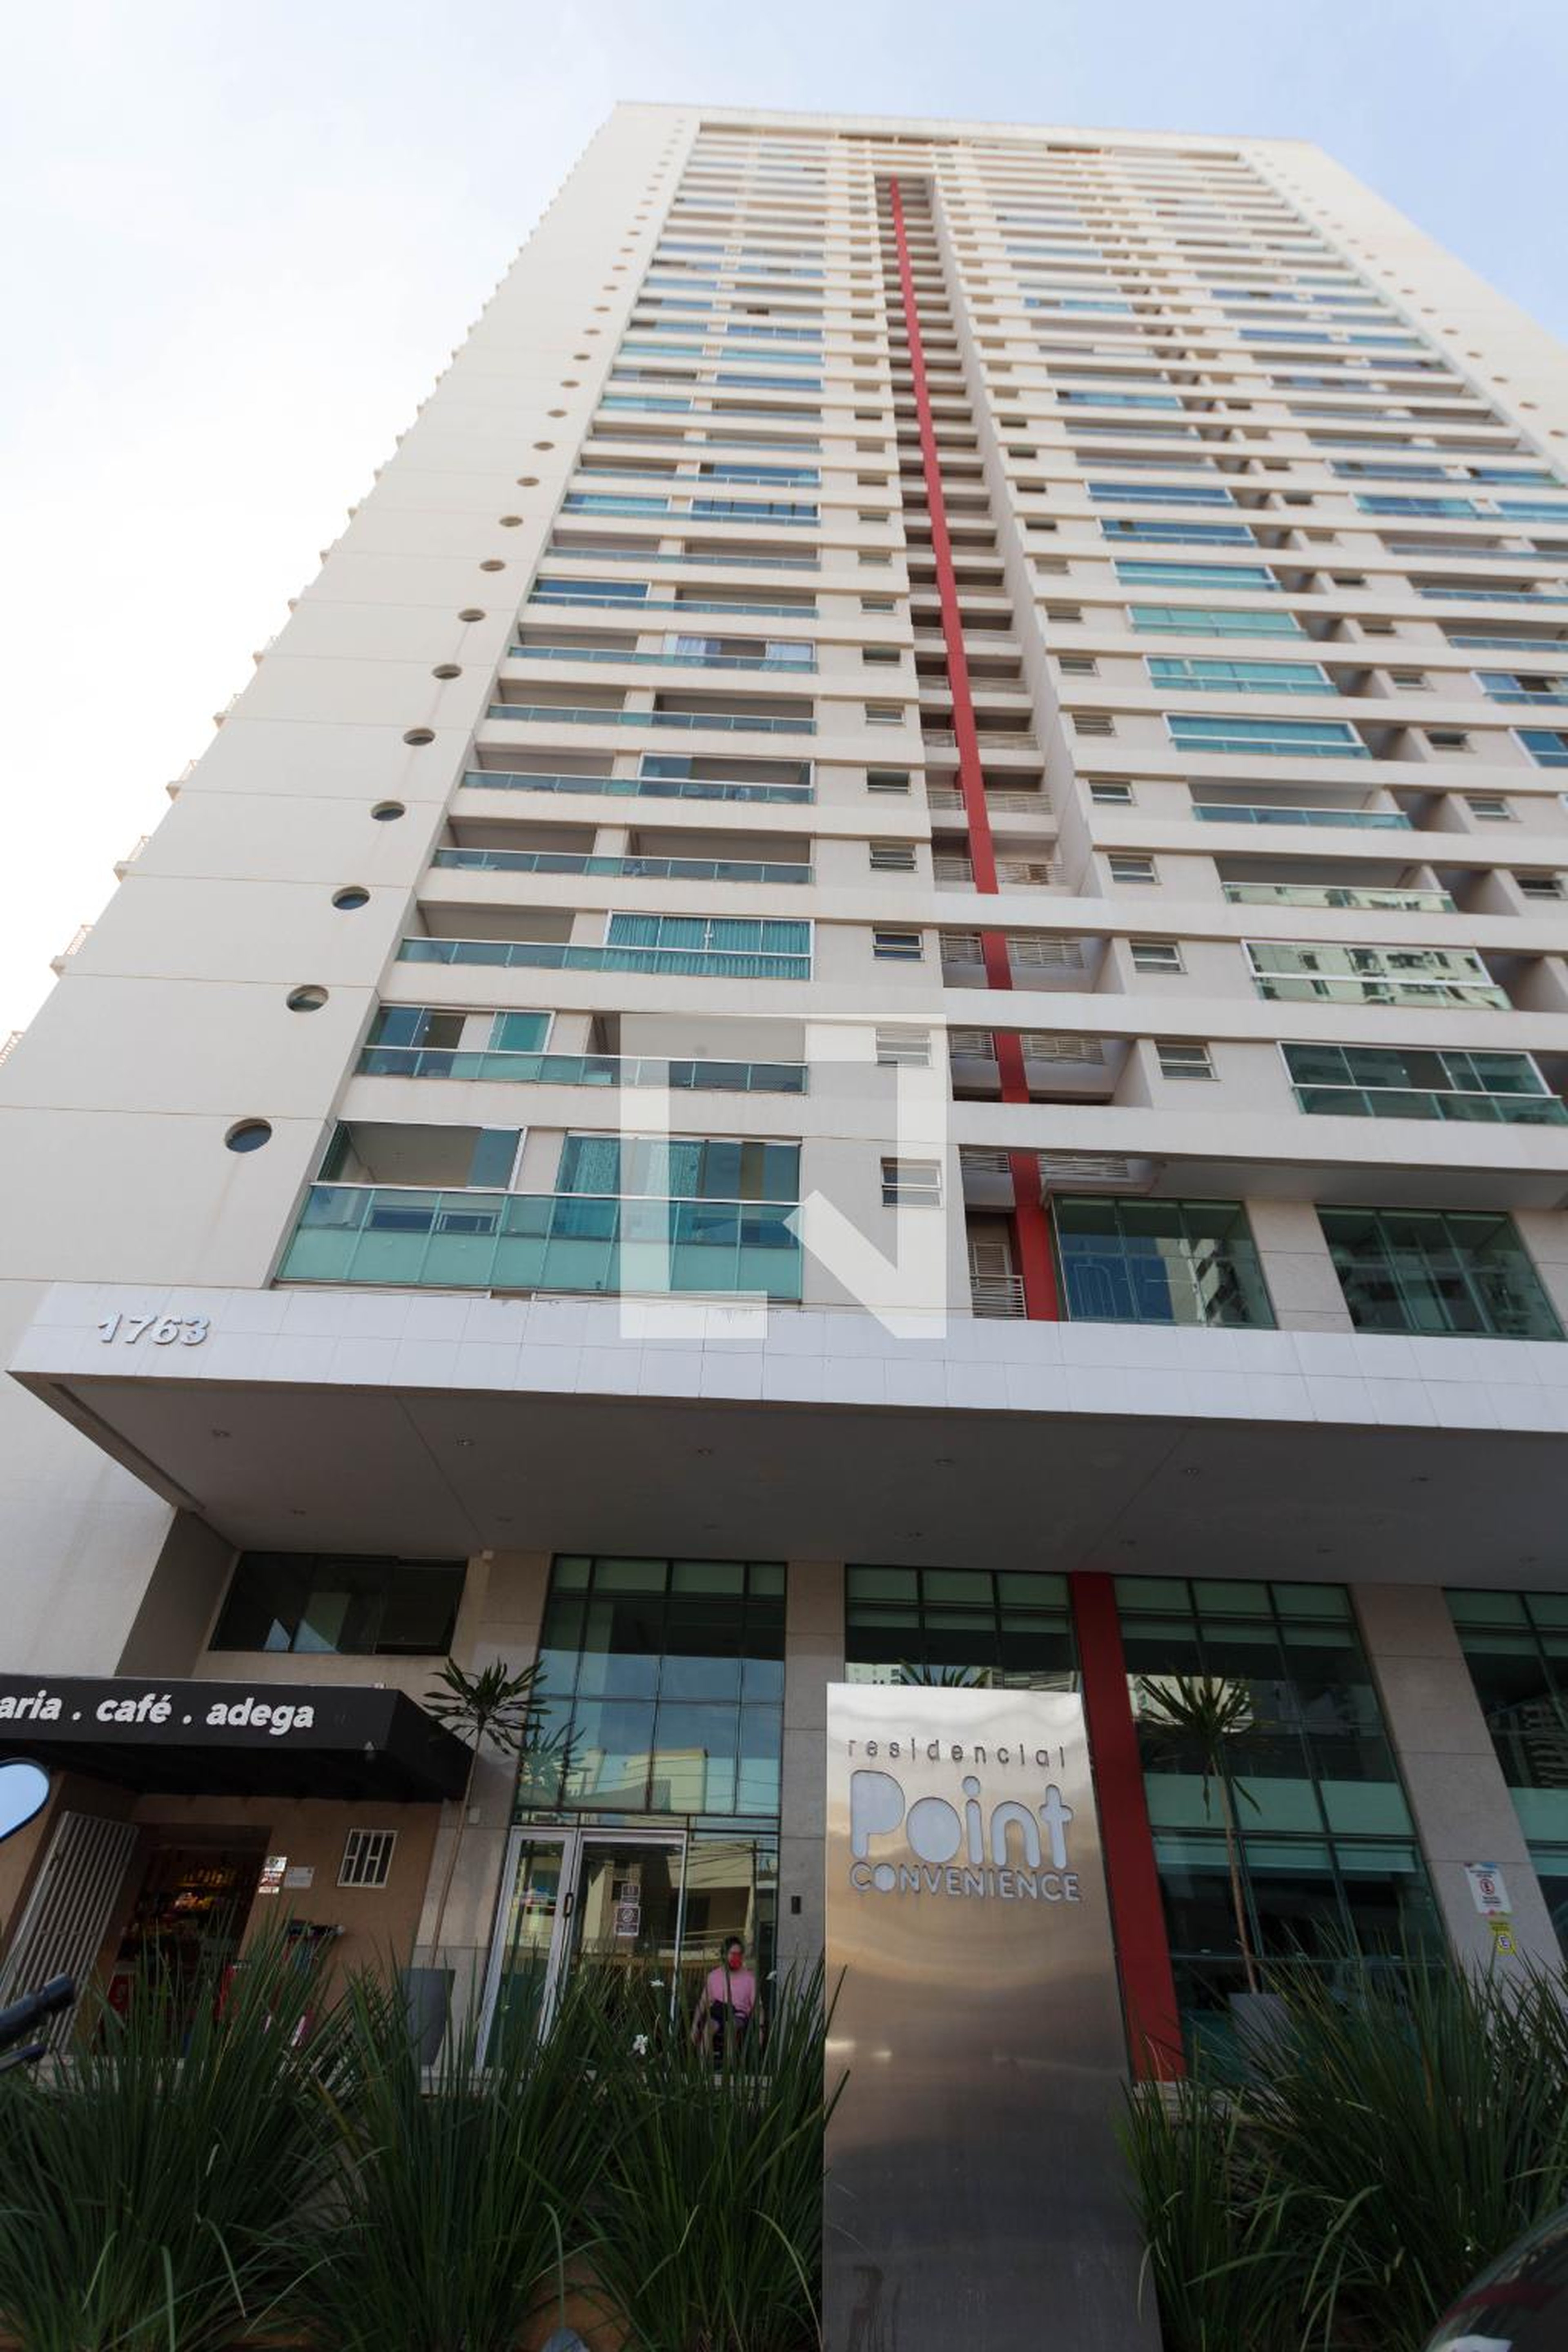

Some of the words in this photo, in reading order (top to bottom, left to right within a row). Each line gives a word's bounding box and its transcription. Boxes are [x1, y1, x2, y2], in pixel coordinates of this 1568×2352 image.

[98, 1311, 211, 1345] 1763
[0, 1690, 62, 1720] aria
[96, 1694, 172, 1723] café
[206, 1697, 315, 1735] adega
[848, 1738, 1066, 1768] residencial
[851, 1770, 1073, 1869] Point
[851, 1861, 1080, 1901] CONVENIENCE
